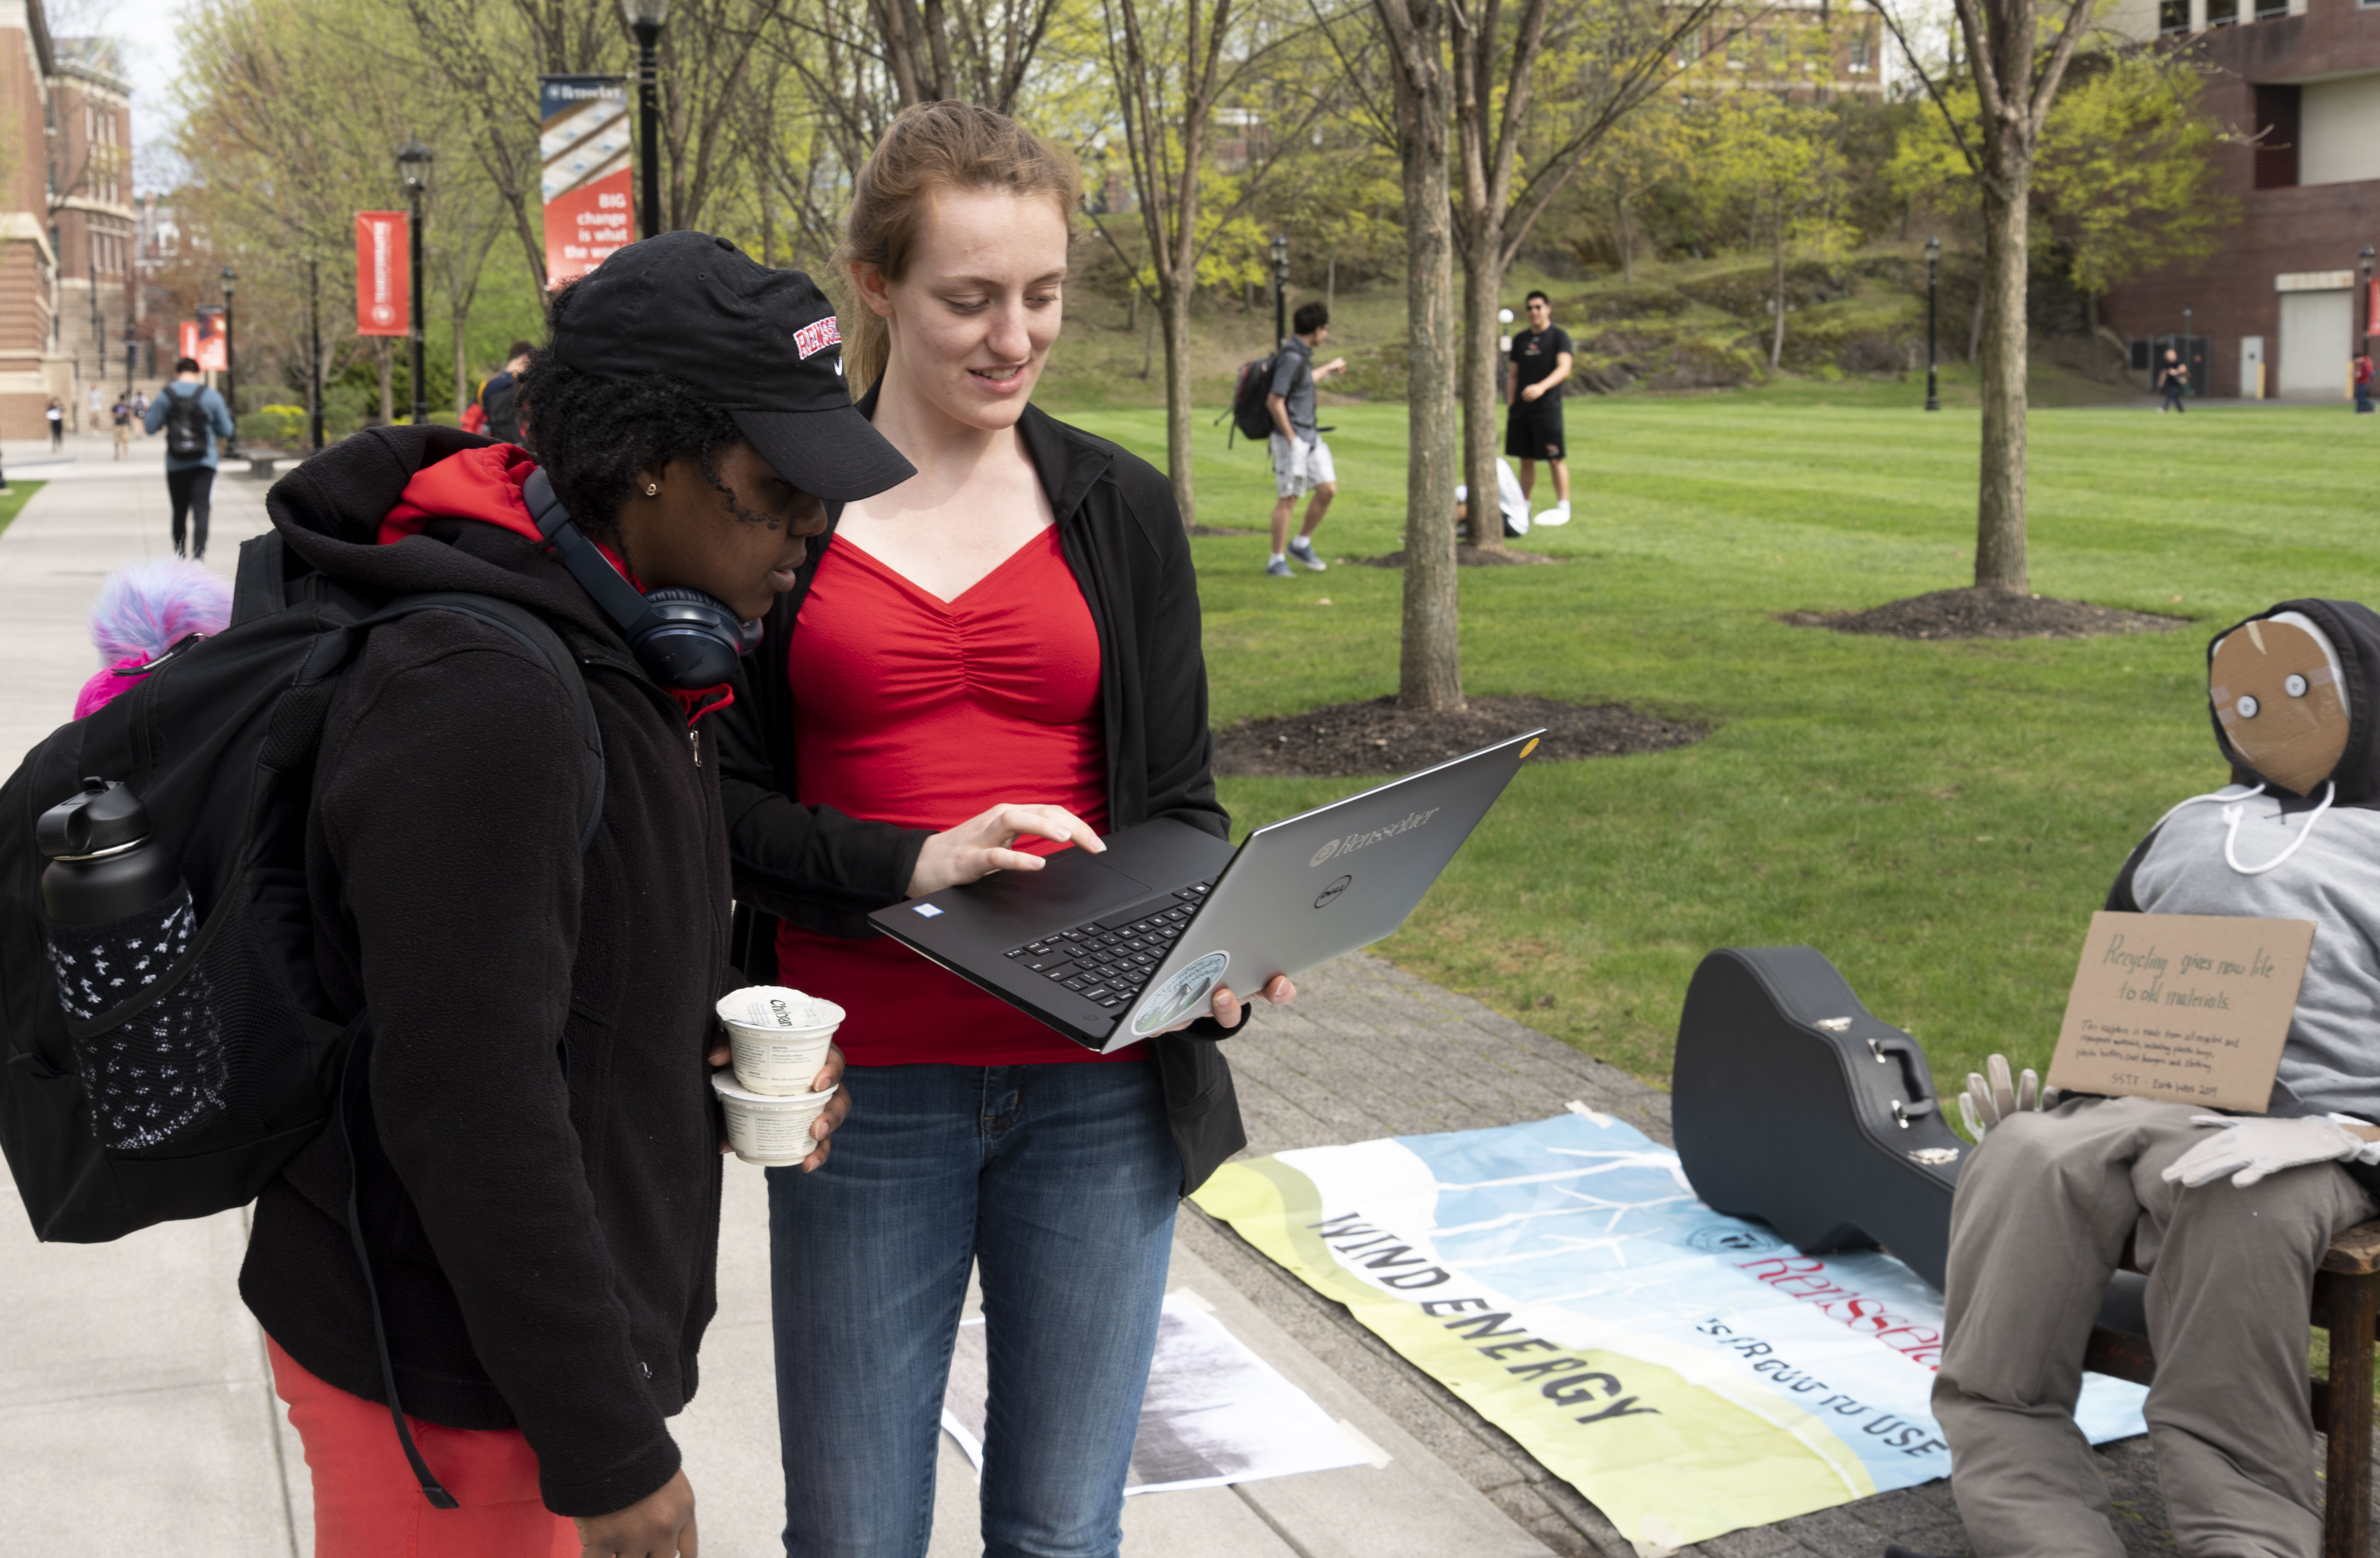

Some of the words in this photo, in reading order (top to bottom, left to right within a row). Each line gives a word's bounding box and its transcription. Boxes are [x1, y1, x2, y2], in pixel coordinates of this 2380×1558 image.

[599, 193, 626, 208] BIG
[577, 210, 627, 227] change
[579, 227, 591, 242] is
[594, 227, 627, 242] what
[564, 245, 588, 259] the
[1333, 807, 1440, 858] Rensselaer
[2103, 934, 2169, 979] Recycling
[2180, 953, 2214, 975] gives
[2217, 960, 2246, 975] new
[2250, 947, 2275, 978] life
[2119, 981, 2136, 1000] to
[2140, 978, 2163, 1003] old
[1305, 1212, 1451, 1290] WIND
[1421, 1297, 1662, 1424] ENERGY
[1863, 1415, 1948, 1458] USE
